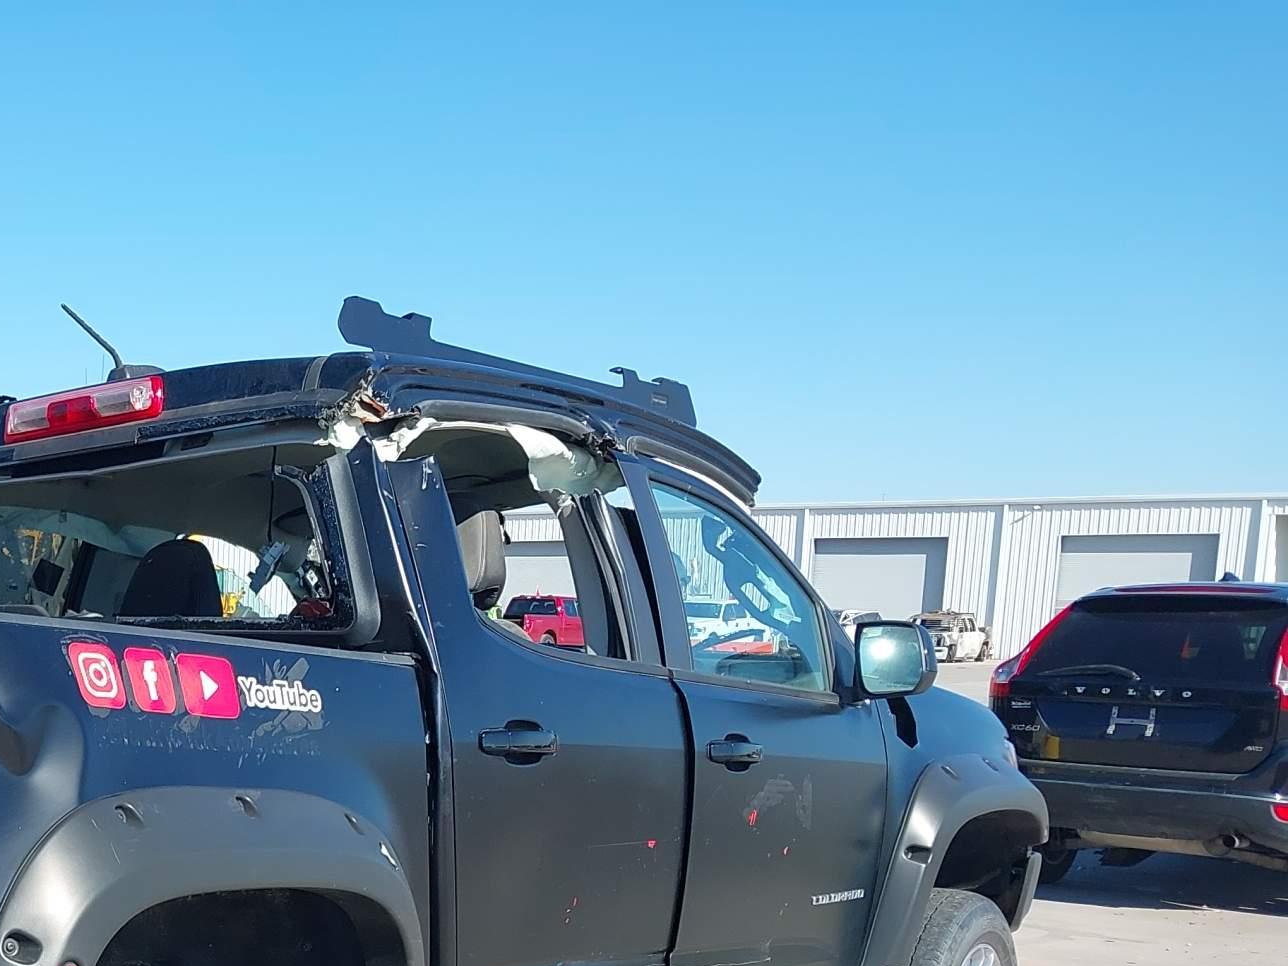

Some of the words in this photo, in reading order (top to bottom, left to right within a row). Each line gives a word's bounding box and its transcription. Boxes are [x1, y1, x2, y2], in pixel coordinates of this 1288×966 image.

[238, 676, 322, 712] YouTube
[1074, 686, 1192, 698] VOLVO
[811, 888, 865, 906] COLORADO
